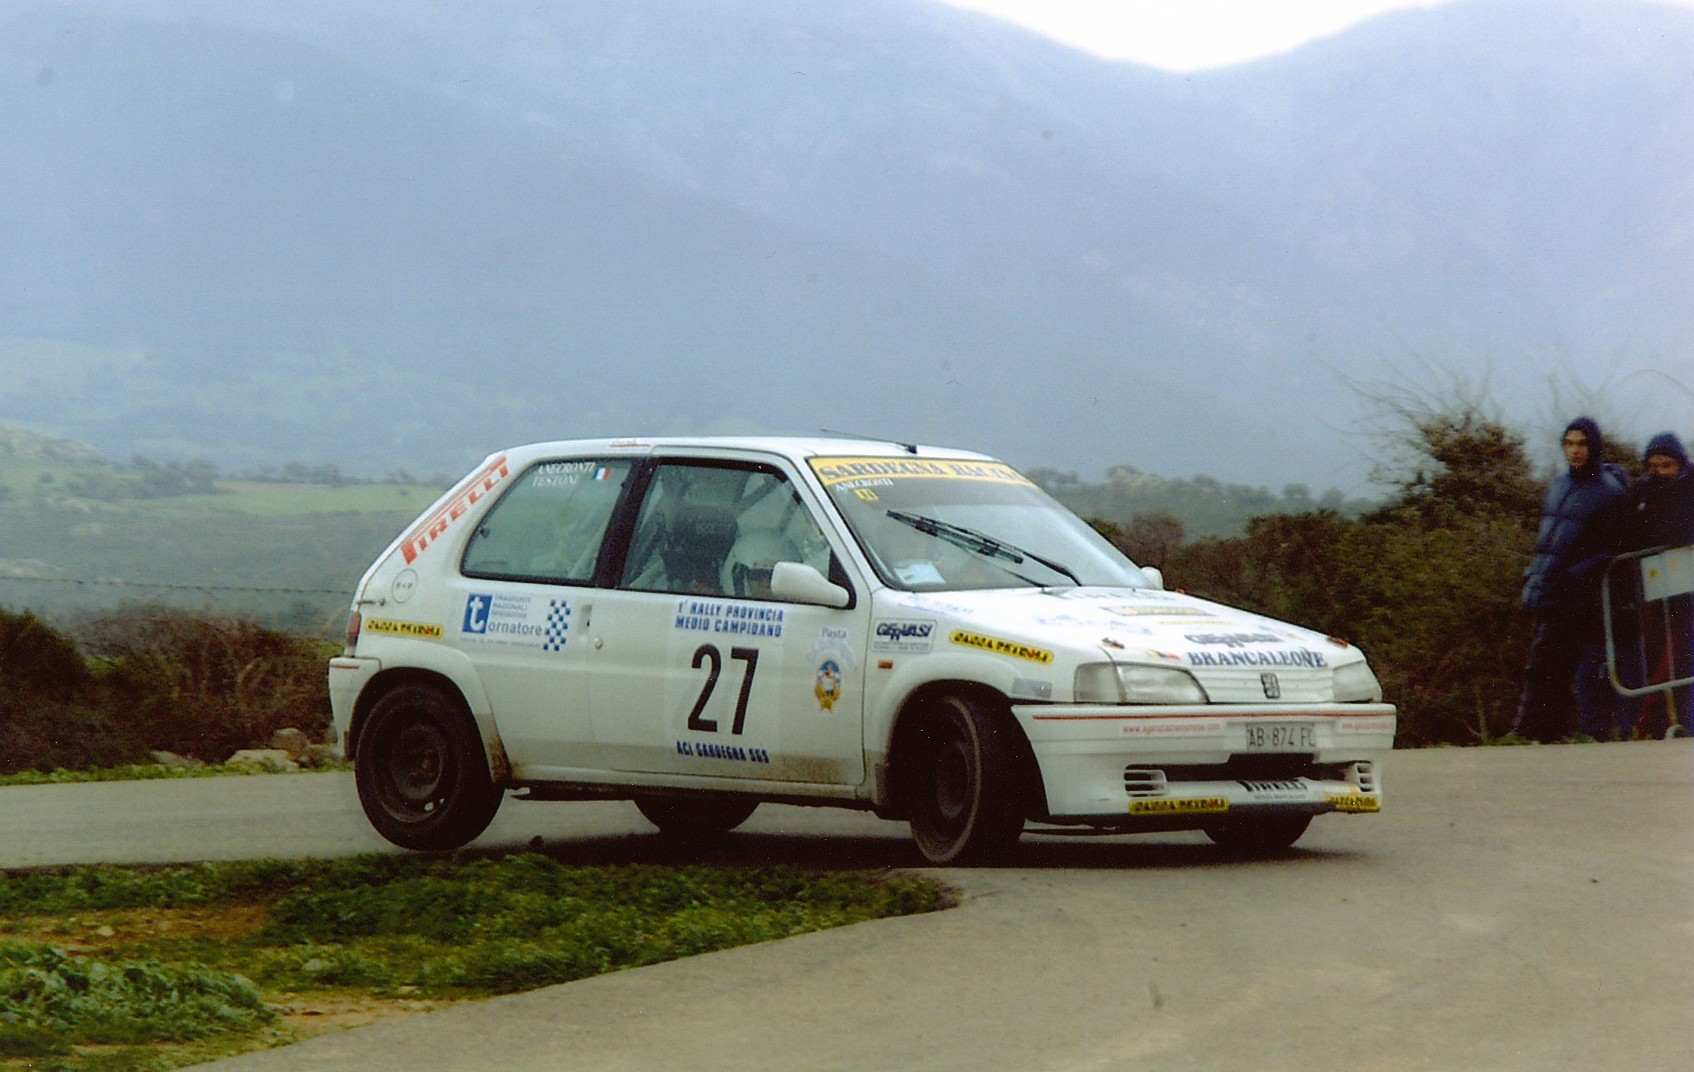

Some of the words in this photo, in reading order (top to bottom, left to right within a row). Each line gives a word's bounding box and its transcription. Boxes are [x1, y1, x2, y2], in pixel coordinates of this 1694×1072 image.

[400, 456, 508, 565] PIRELLI
[691, 602, 722, 616] RALLY
[726, 605, 784, 622] PROVINCIA
[675, 615, 710, 631] MEDIO
[714, 619, 782, 637] CAMPIDANO
[1187, 649, 1328, 668] BRANCALEONE
[688, 643, 759, 735] 27
[1272, 727, 1294, 746] 874
[696, 743, 747, 761] SARDEGNA
